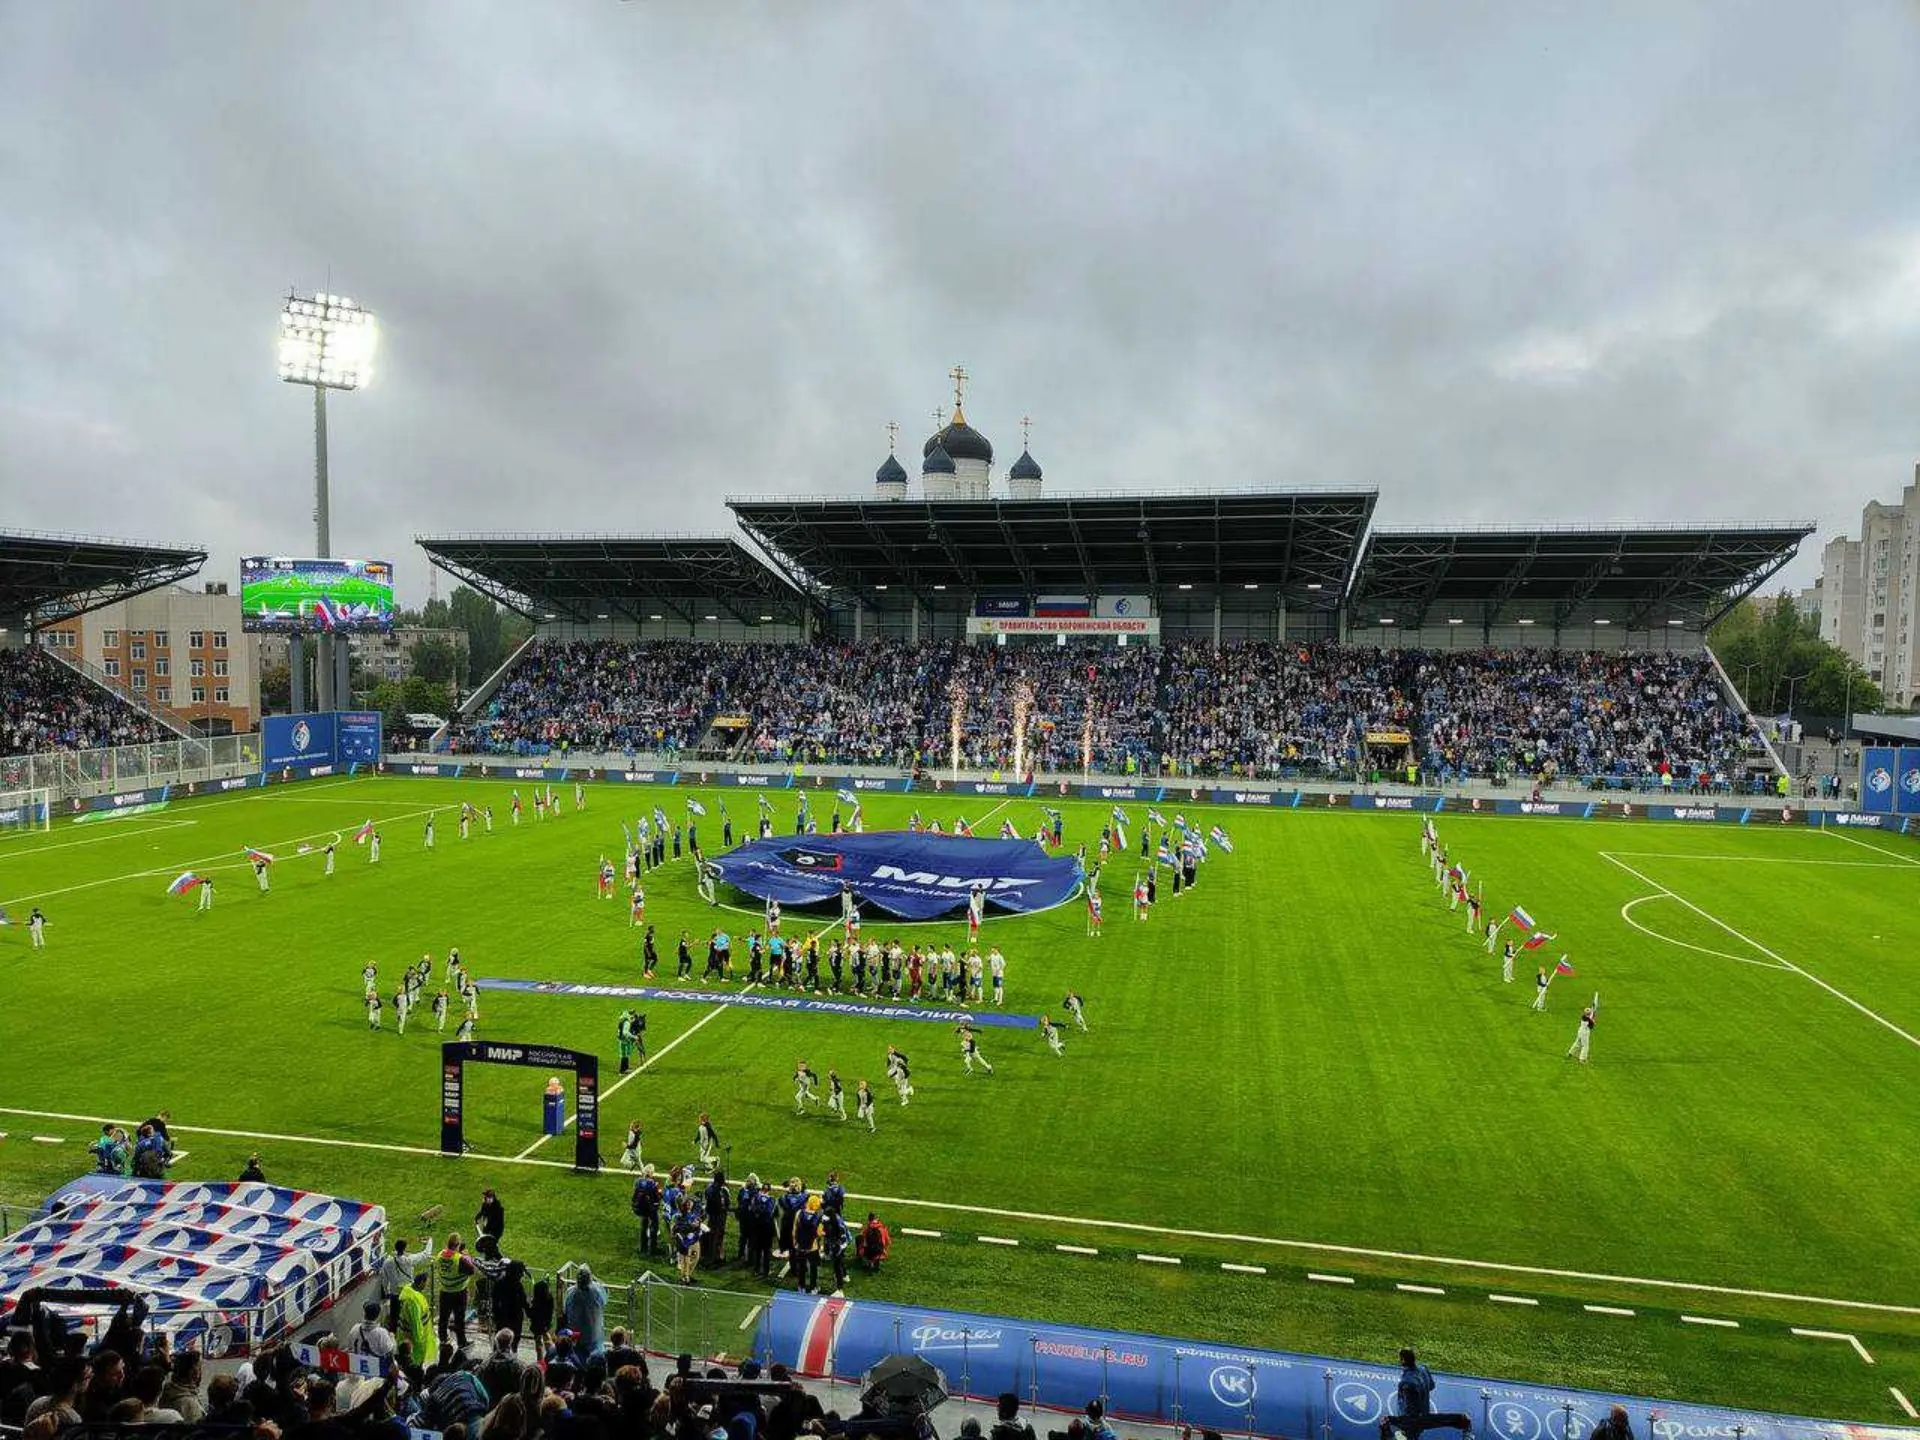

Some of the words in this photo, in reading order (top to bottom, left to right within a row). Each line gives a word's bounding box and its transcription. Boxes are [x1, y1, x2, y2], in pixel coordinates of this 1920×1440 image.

[653, 990, 801, 1008] РОССИЙСКАЯ
[806, 1001, 975, 1021] ПРЕМЬЕР-ЛИГА
[488, 1047, 523, 1060] МИР
